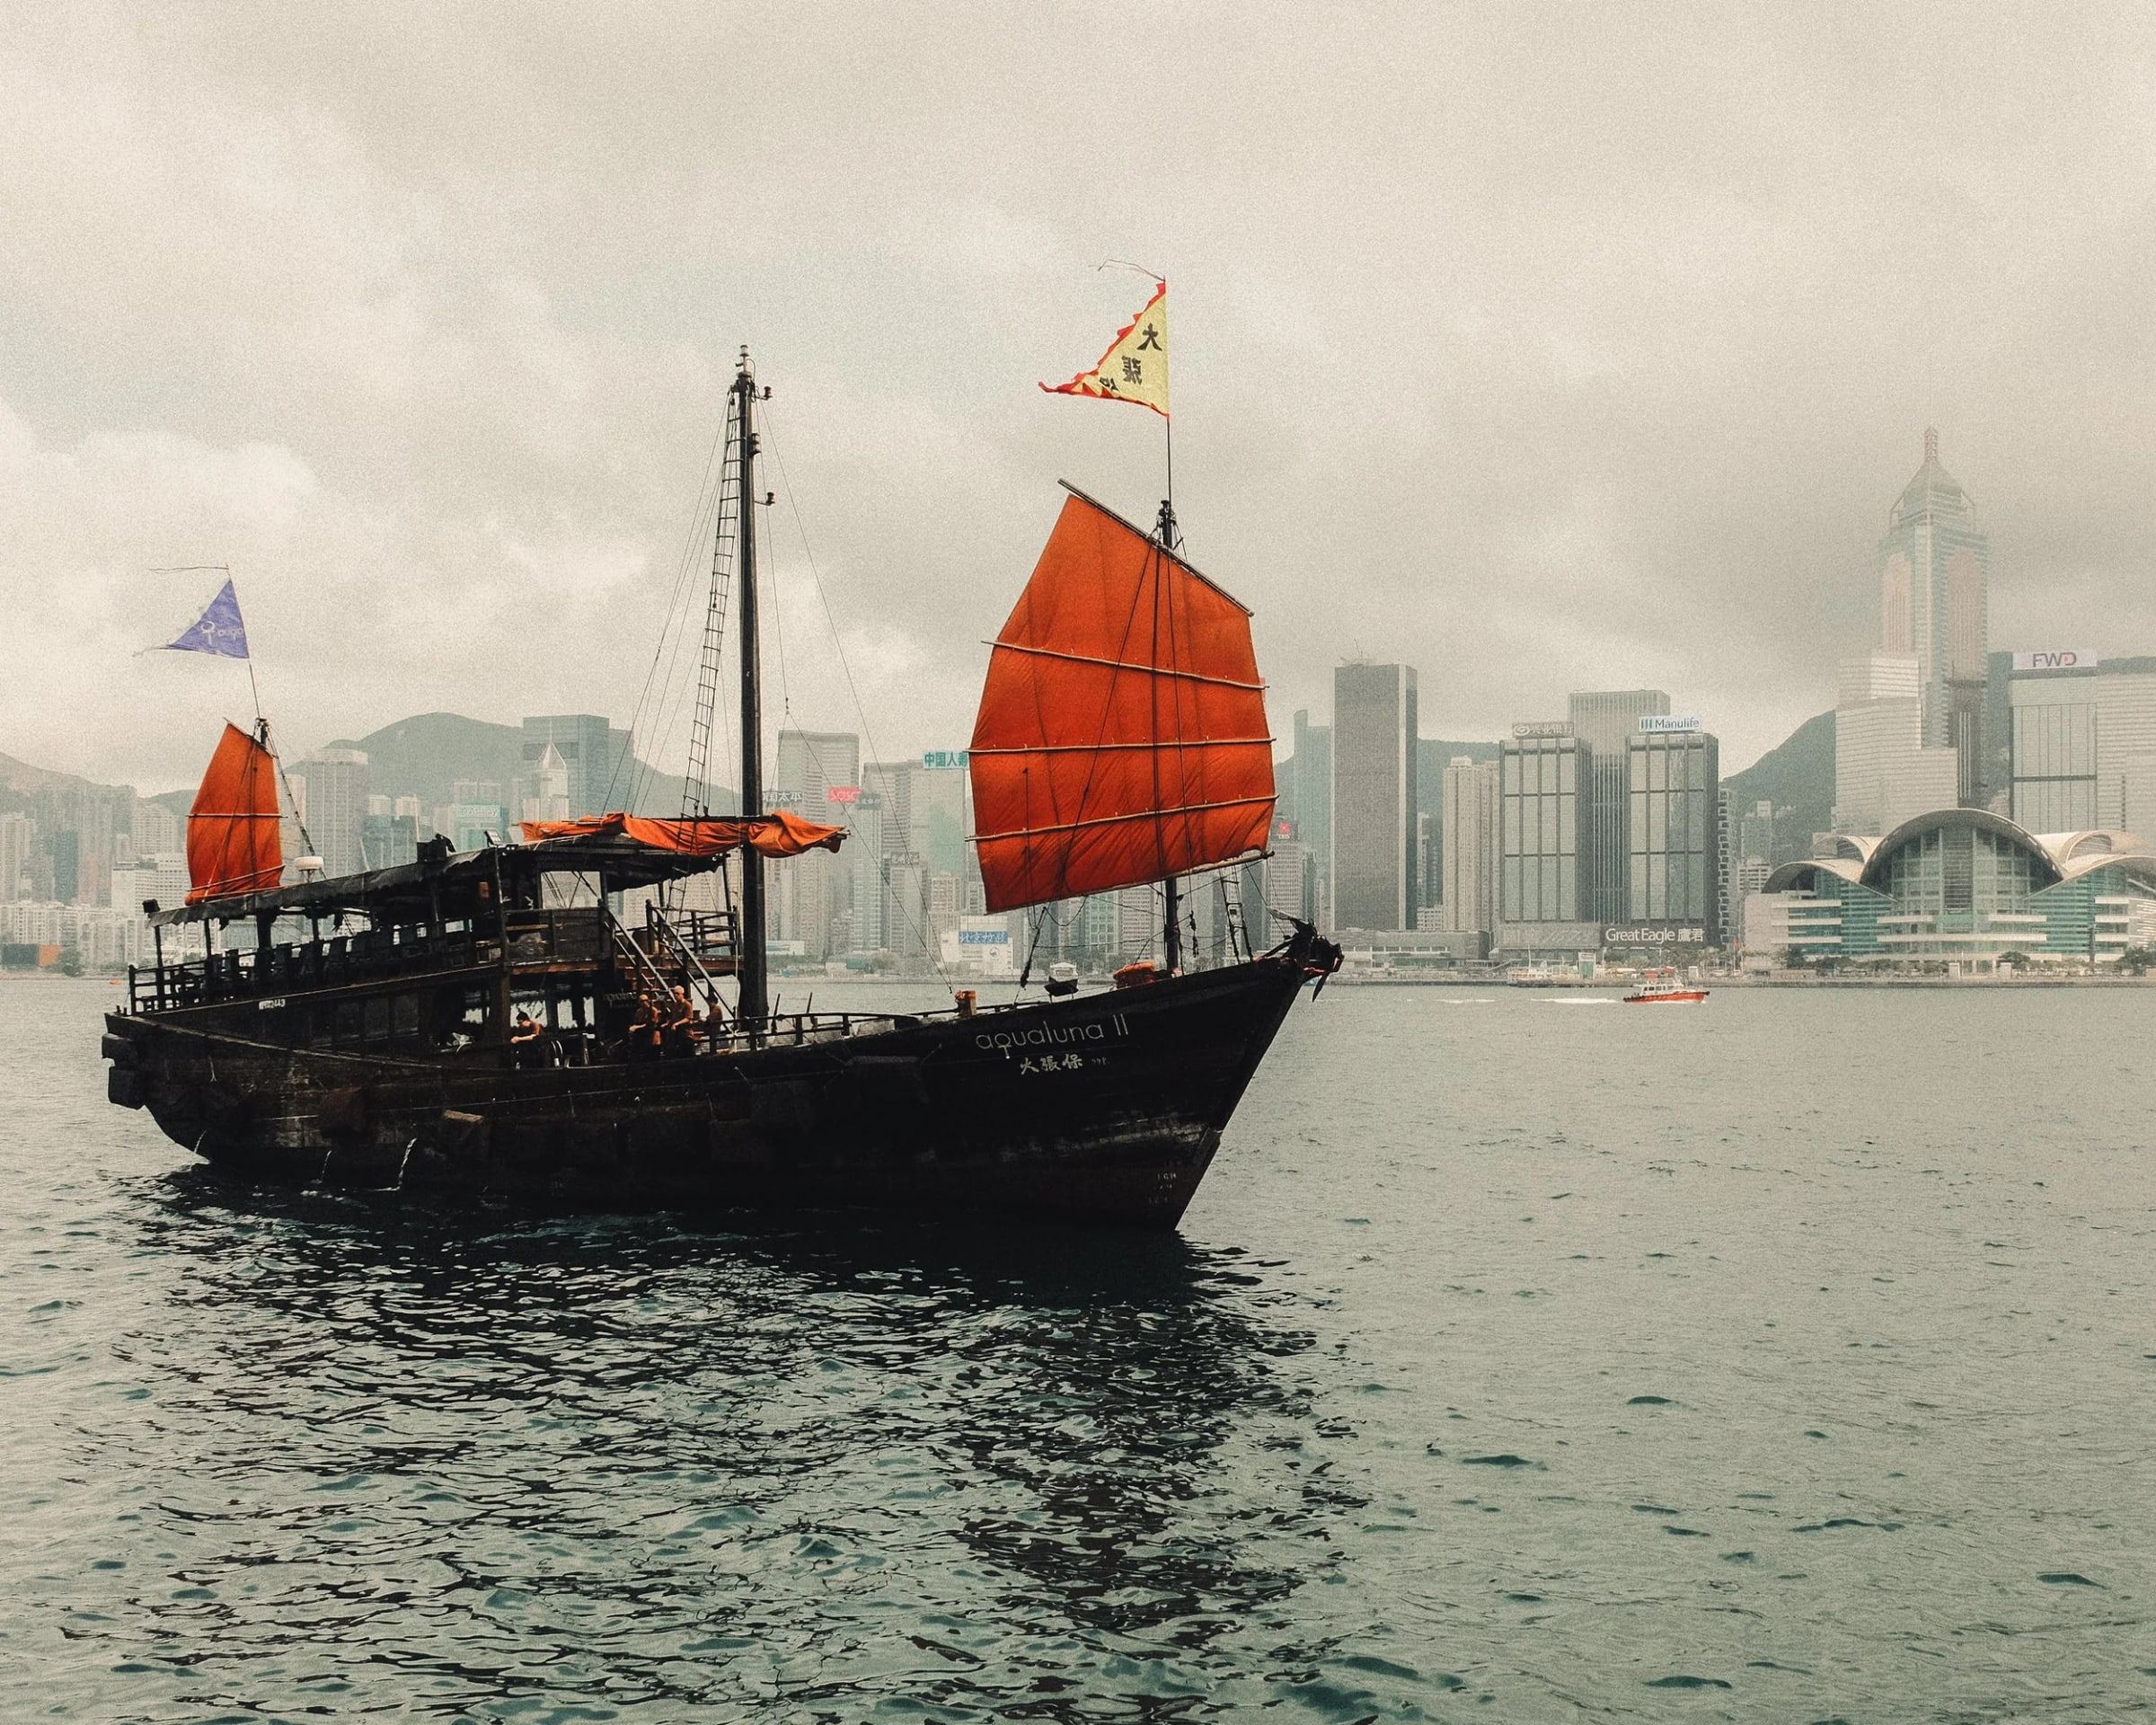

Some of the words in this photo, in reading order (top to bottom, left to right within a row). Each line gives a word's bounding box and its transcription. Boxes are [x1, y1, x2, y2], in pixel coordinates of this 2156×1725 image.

[2032, 651, 2077, 668] FWD
[1655, 717, 1700, 730] Manulife
[762, 791, 803, 802] 国太平
[1604, 927, 1640, 942] Great
[1641, 927, 1676, 945] Eagle
[976, 1020, 1105, 1060] aqualuna
